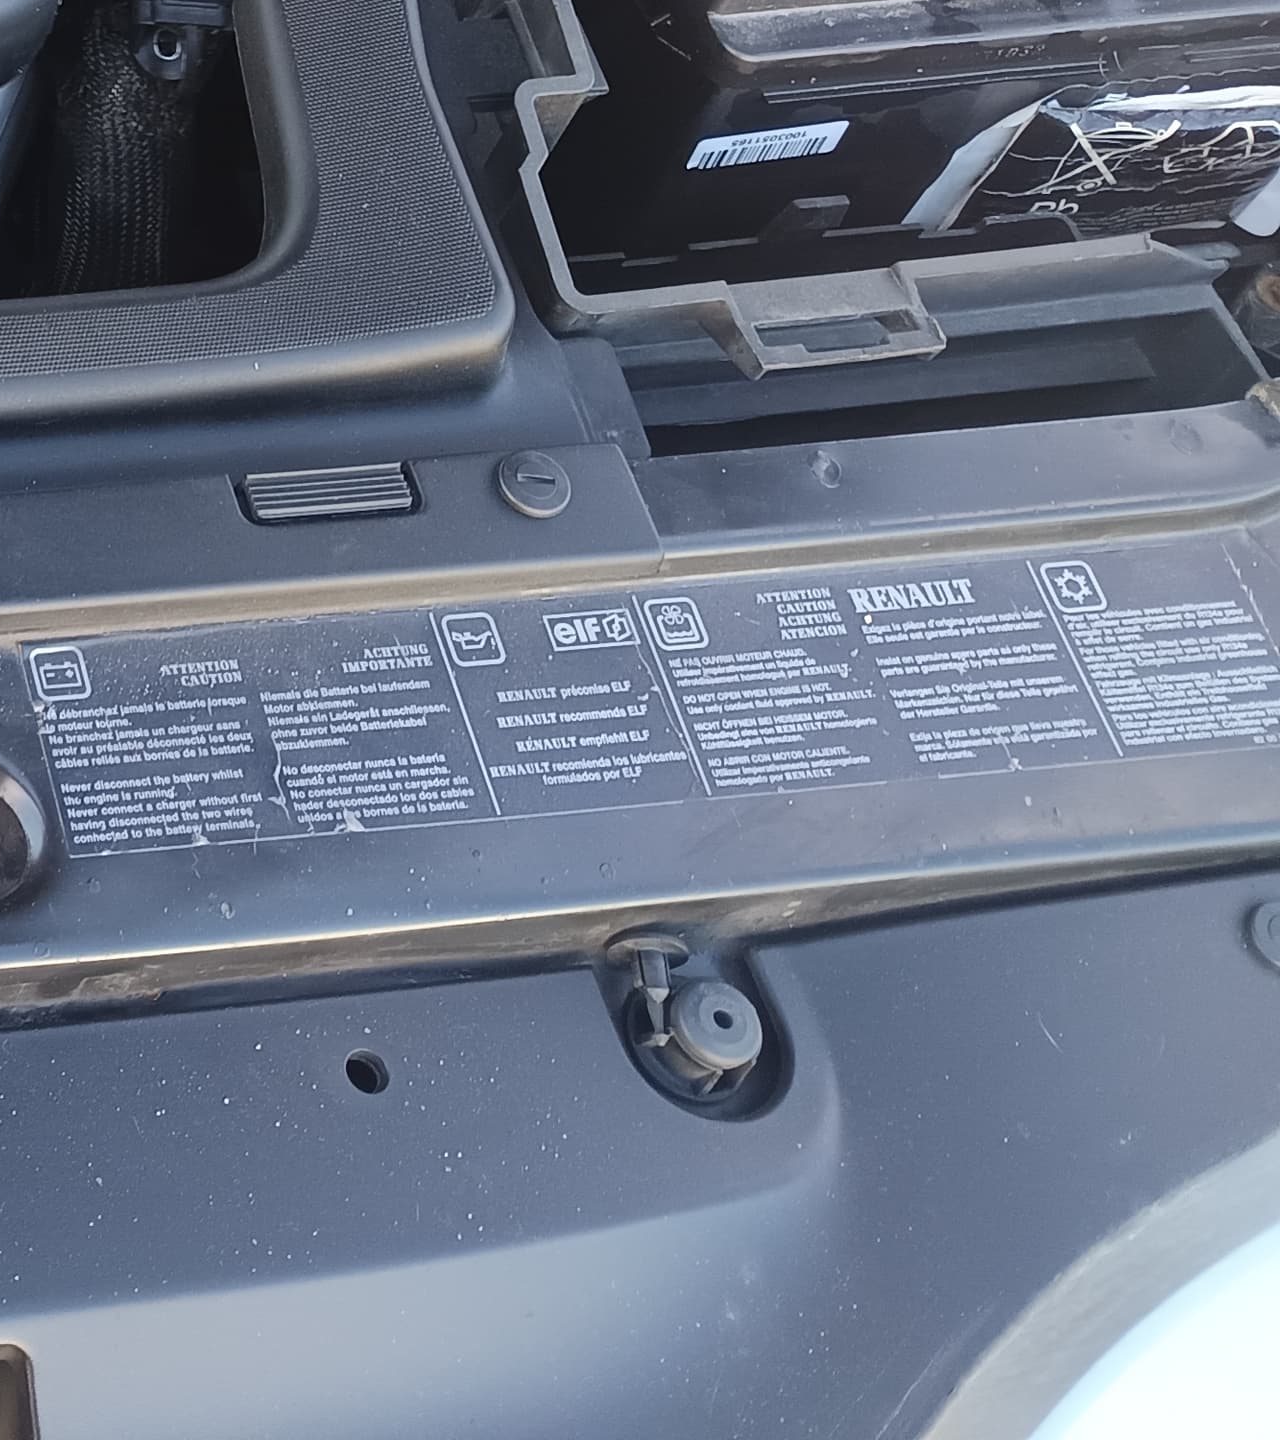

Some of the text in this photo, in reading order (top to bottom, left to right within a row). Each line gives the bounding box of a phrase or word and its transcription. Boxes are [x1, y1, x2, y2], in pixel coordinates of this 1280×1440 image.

[757, 588, 831, 604] ATTENTION
[848, 578, 976, 614] RENAULT
[777, 600, 836, 614] CAUTION
[778, 611, 842, 626] ACHTUNG
[553, 618, 602, 644] elf
[780, 623, 847, 640] ATENCION
[363, 643, 429, 658] ACHTUNG
[159, 659, 239, 676] ATTENTION
[342, 656, 433, 674] IMPORTANTE
[181, 671, 242, 686] CAUTION
[496, 680, 631, 703] RENAULT préconise ELF
[496, 705, 648, 728] RENAULT ELF
[515, 736, 576, 753] RENAULT
[630, 729, 650, 742] ELF
[489, 749, 687, 779] RENAULT recomienda los lubricantes
[61, 769, 243, 793] Never disconnect the battery whilst
[542, 766, 642, 785] formulados por ELF
[67, 808, 97, 818] Never
[101, 803, 143, 815] connect
[156, 799, 196, 810] charger
[199, 795, 238, 806] without
[241, 792, 262, 803] first
[84, 793, 119, 805] engine
[121, 791, 131, 800] is
[134, 786, 177, 800] running.
[71, 807, 253, 831] having disconnected the two wires
[131, 830, 142, 838] to
[145, 827, 162, 837] the
[206, 819, 260, 831] terminals.
